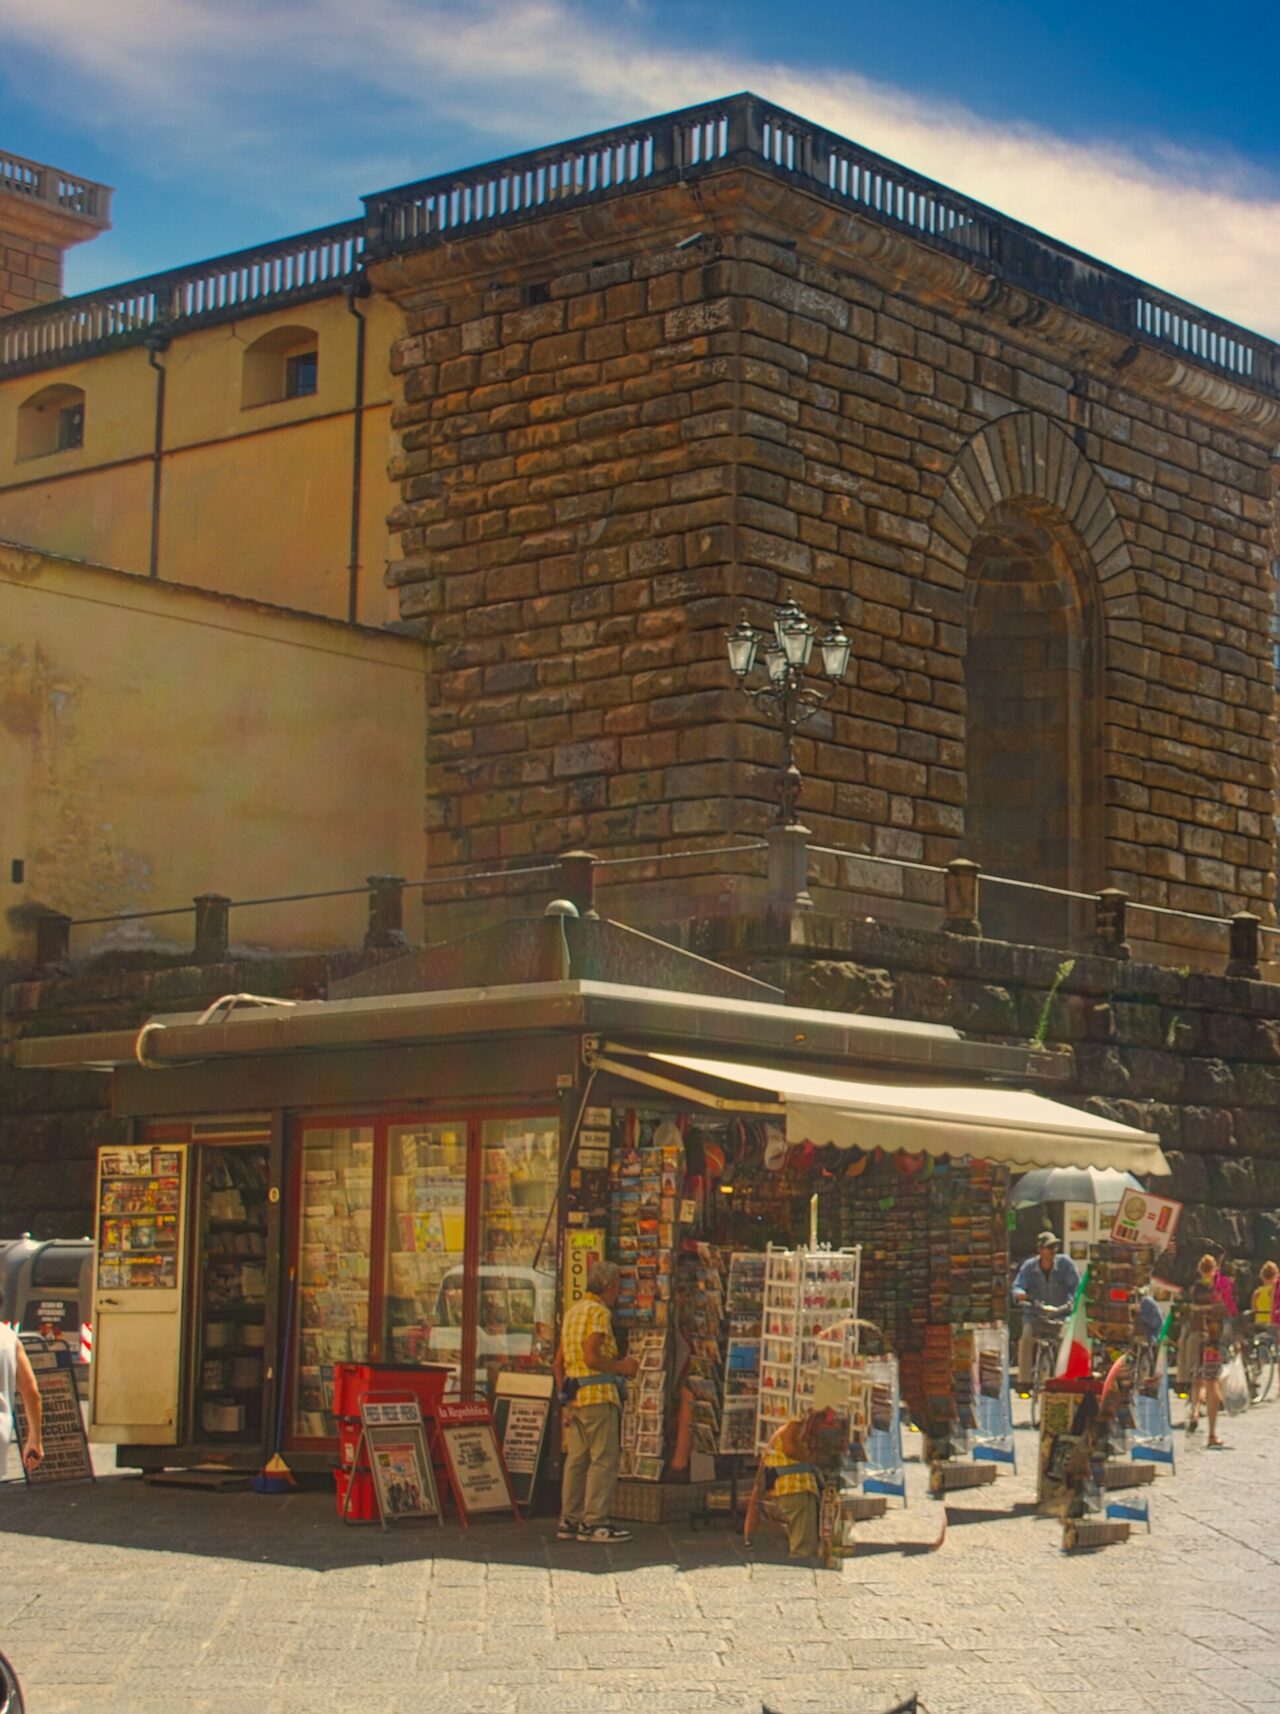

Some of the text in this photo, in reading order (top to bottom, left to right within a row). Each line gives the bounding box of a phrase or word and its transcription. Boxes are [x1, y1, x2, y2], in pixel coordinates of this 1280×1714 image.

[571, 1250, 583, 1301] COLD
[439, 1403, 489, 1419] la Repubblica
